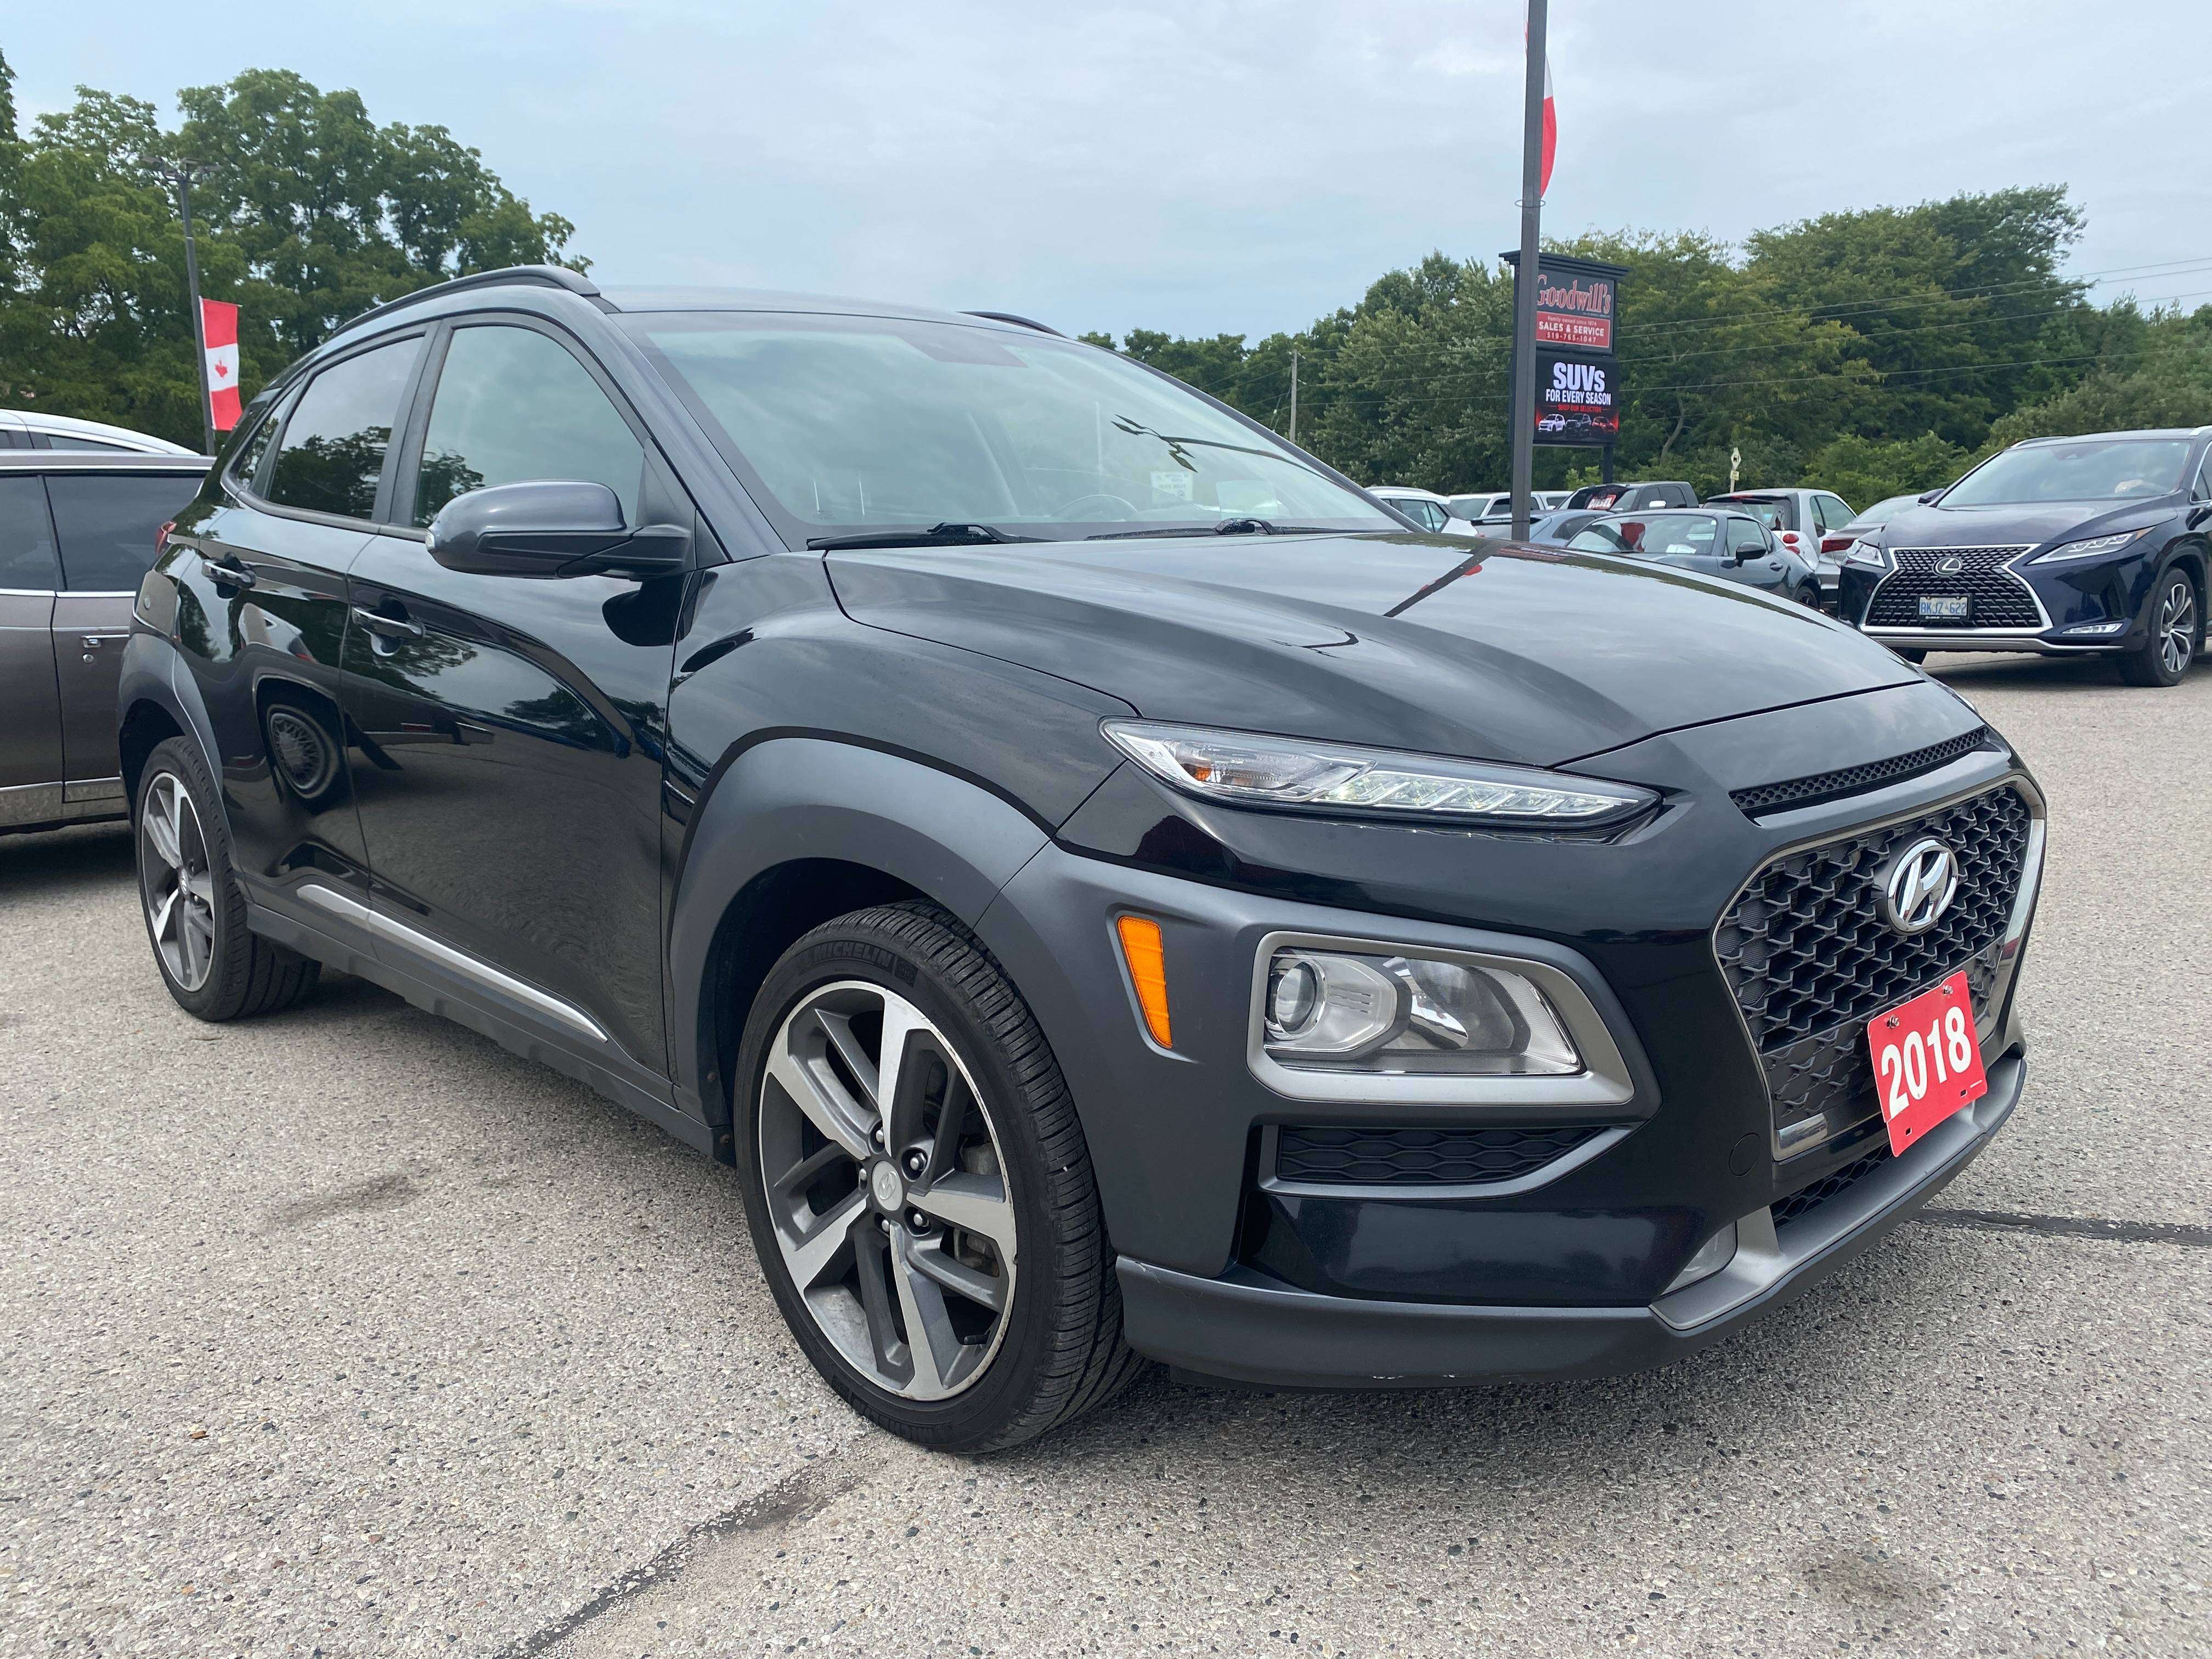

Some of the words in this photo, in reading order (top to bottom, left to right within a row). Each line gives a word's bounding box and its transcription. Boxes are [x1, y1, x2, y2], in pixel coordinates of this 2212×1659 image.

[1539, 320, 1564, 332] SALES
[1566, 324, 1571, 333] &
[1573, 325, 1605, 336] SERVICE
[1547, 331, 1597, 343] 519-765-1047
[1545, 388, 1561, 402] FOR
[1562, 390, 1584, 404] EVERY
[1585, 391, 1611, 405] SEASON
[1950, 602, 1967, 614] 622
[812, 940, 894, 968] MICHELIN
[1881, 1006, 1972, 1119] 2018
